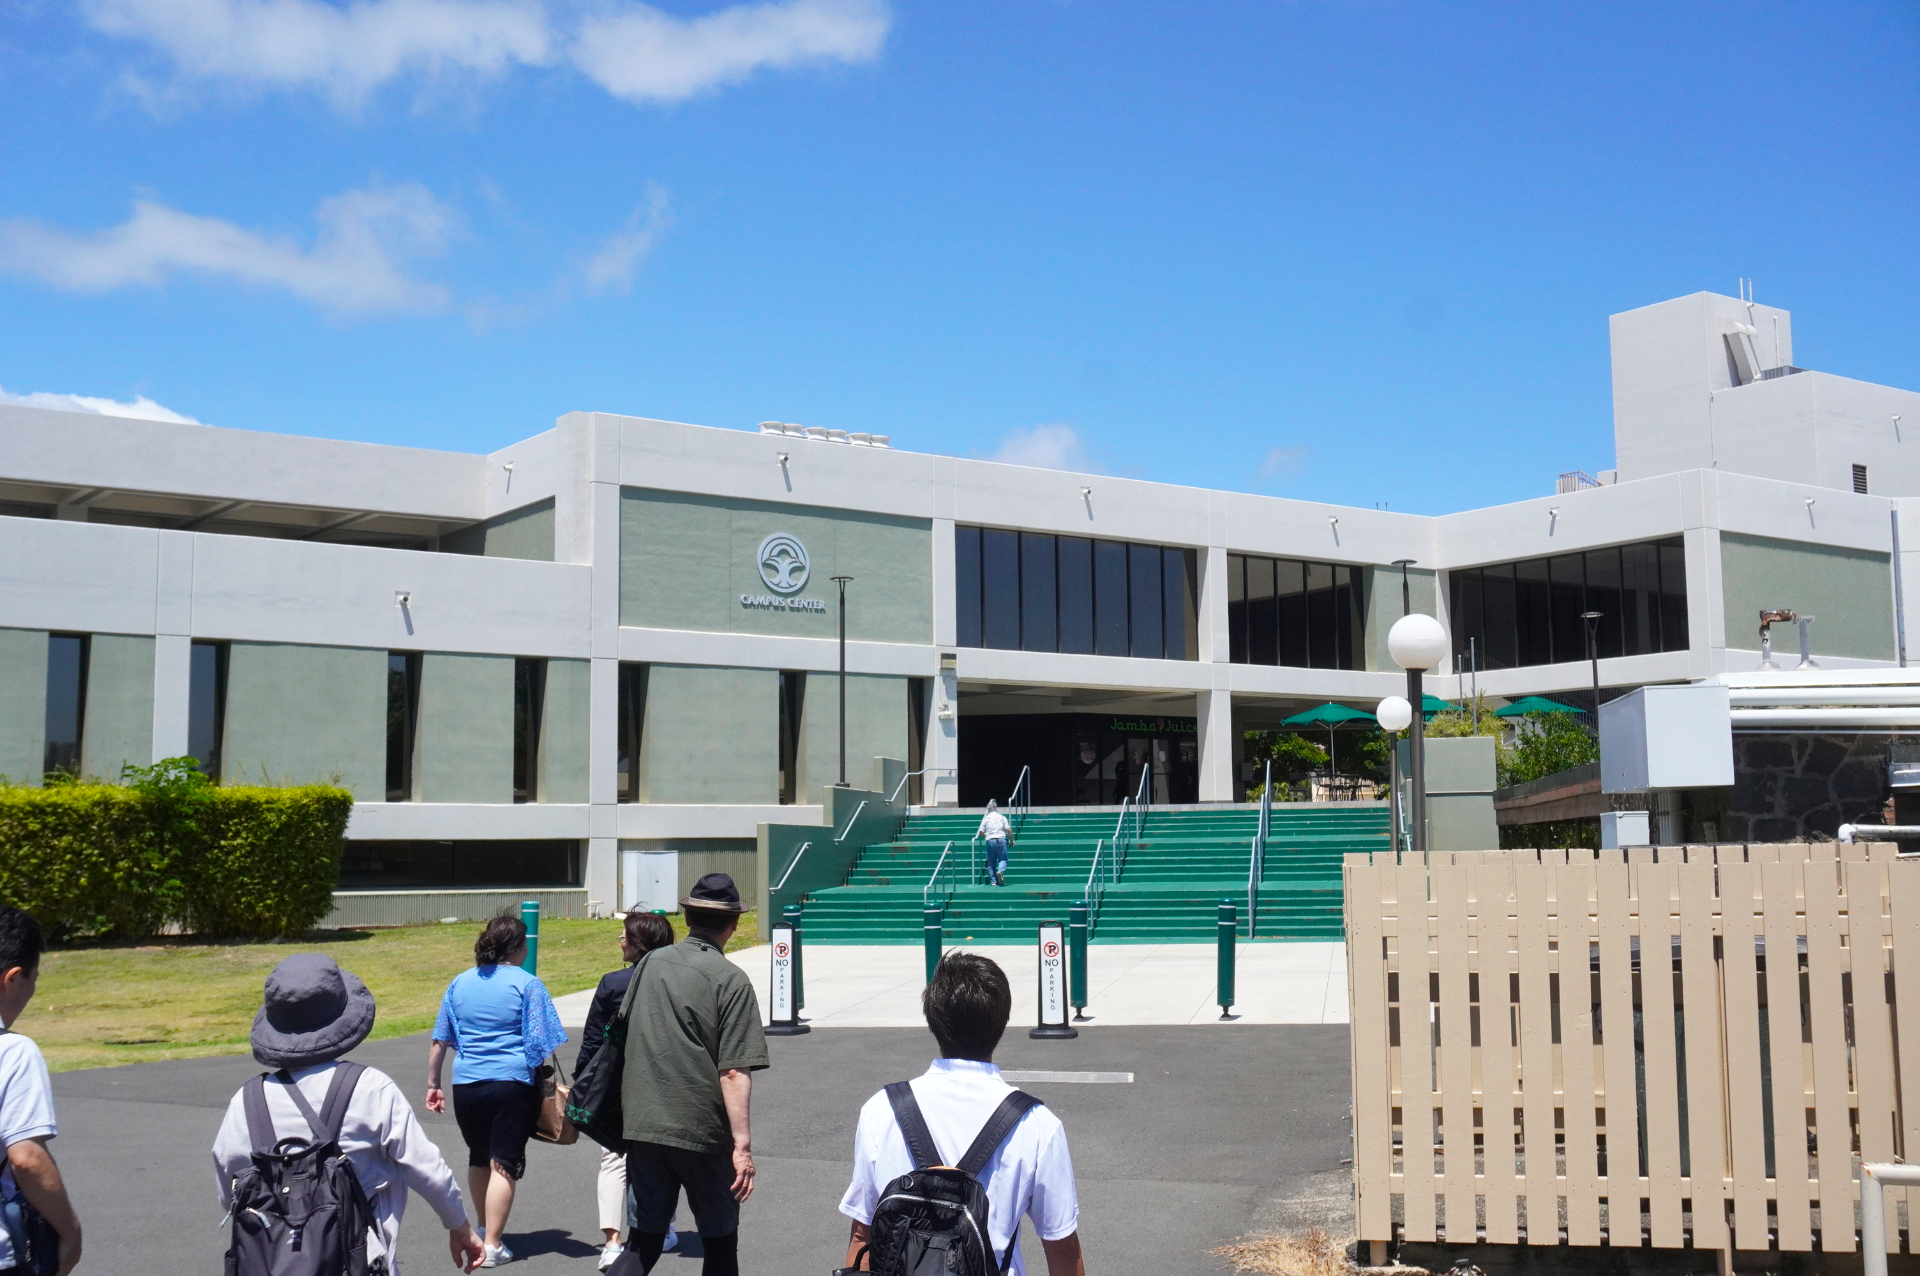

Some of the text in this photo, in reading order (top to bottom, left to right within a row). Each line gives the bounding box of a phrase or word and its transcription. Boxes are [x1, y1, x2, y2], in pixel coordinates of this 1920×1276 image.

[741, 594, 826, 610] CAMPUS CENTER
[1111, 718, 1158, 732] Jamba
[776, 959, 788, 967] NO
[1045, 959, 1059, 967] NO
